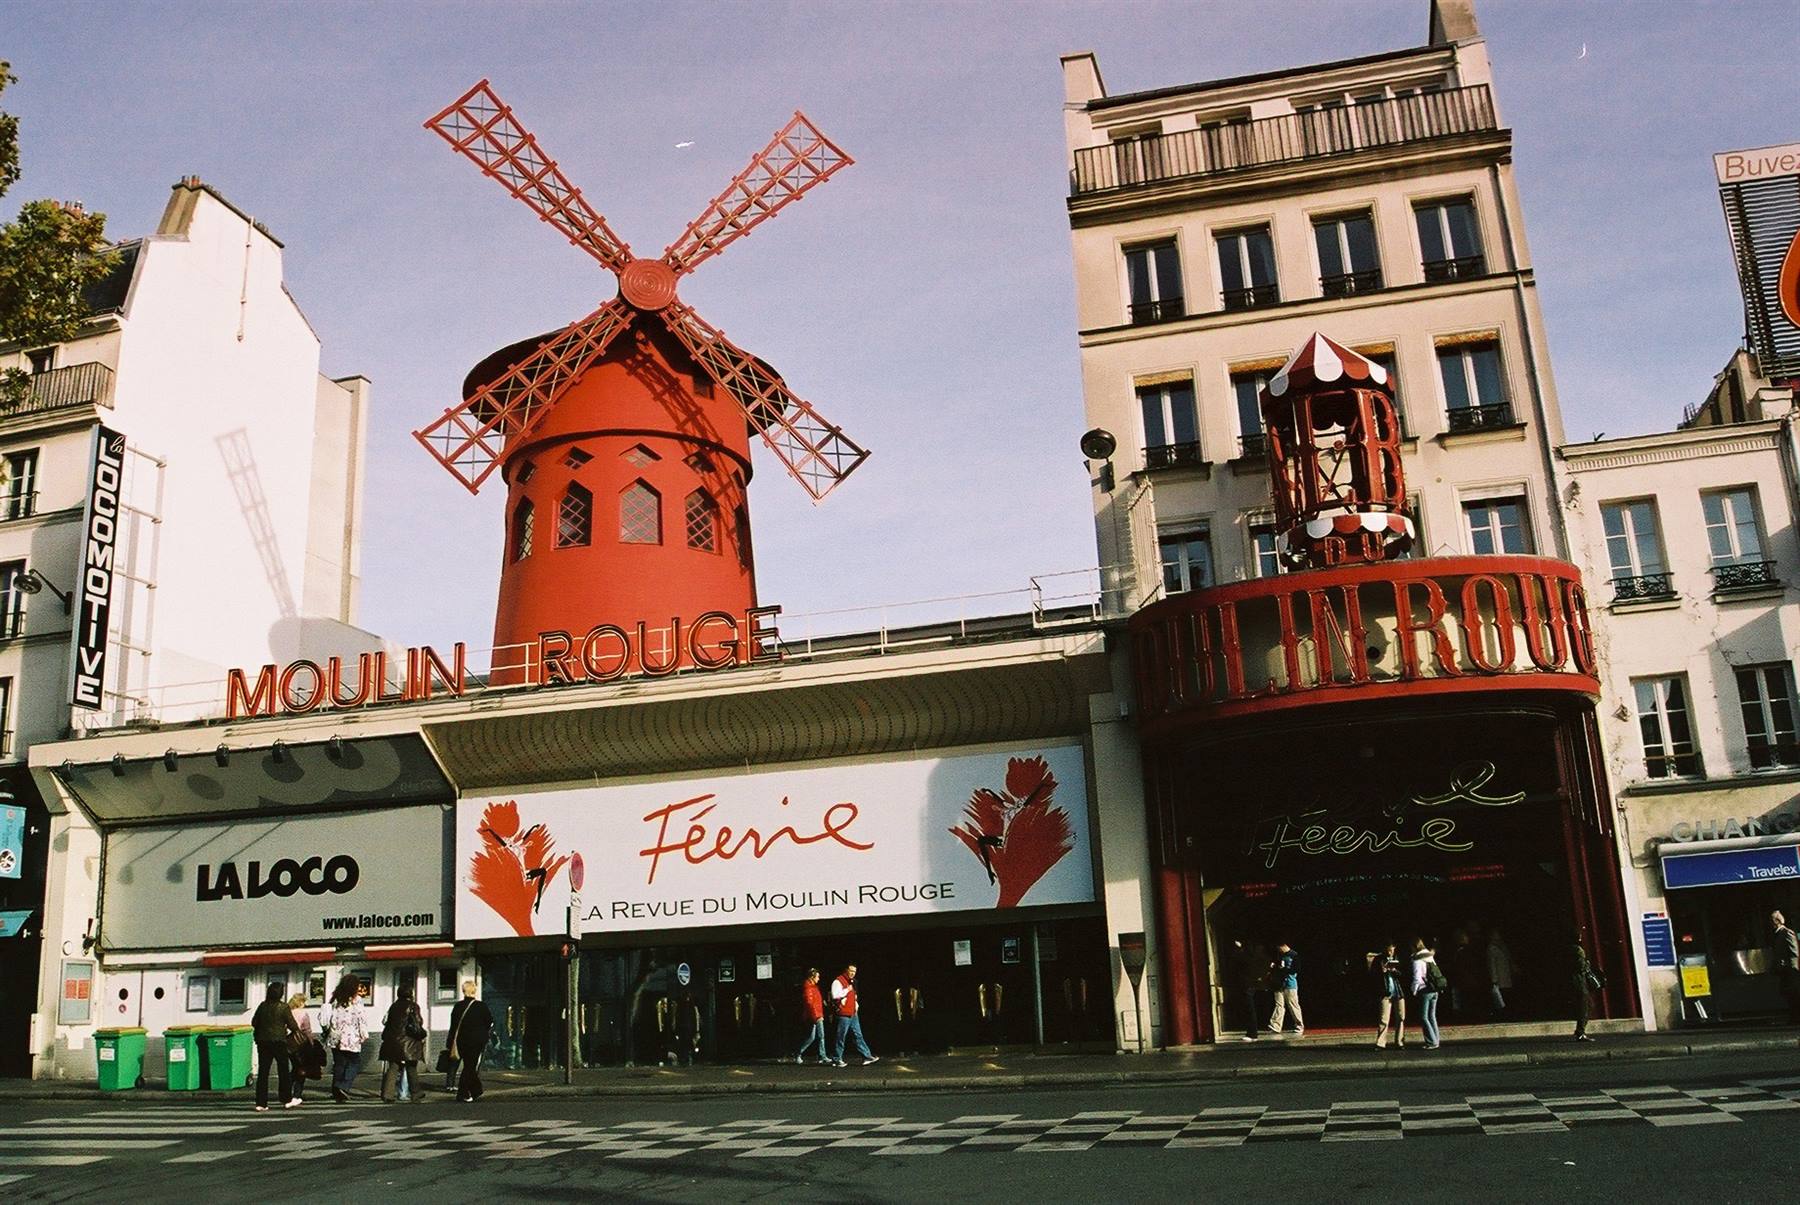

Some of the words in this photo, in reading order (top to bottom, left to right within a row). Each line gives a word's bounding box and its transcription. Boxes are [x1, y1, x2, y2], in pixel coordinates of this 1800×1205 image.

[1324, 532, 1386, 565] DU
[76, 437, 121, 705] LOCOMOTIVE
[226, 642, 466, 720] MOULIN
[537, 604, 783, 686] ROUGE
[639, 793, 874, 885] Féerie
[197, 862, 244, 901] LA
[247, 855, 360, 898] LOCO
[1748, 864, 1798, 879] Travelex
[702, 897, 738, 914] DU
[746, 888, 849, 911] MOULIN
[858, 882, 956, 904] ROUGE
[323, 913, 434, 930] www.laloco.com
